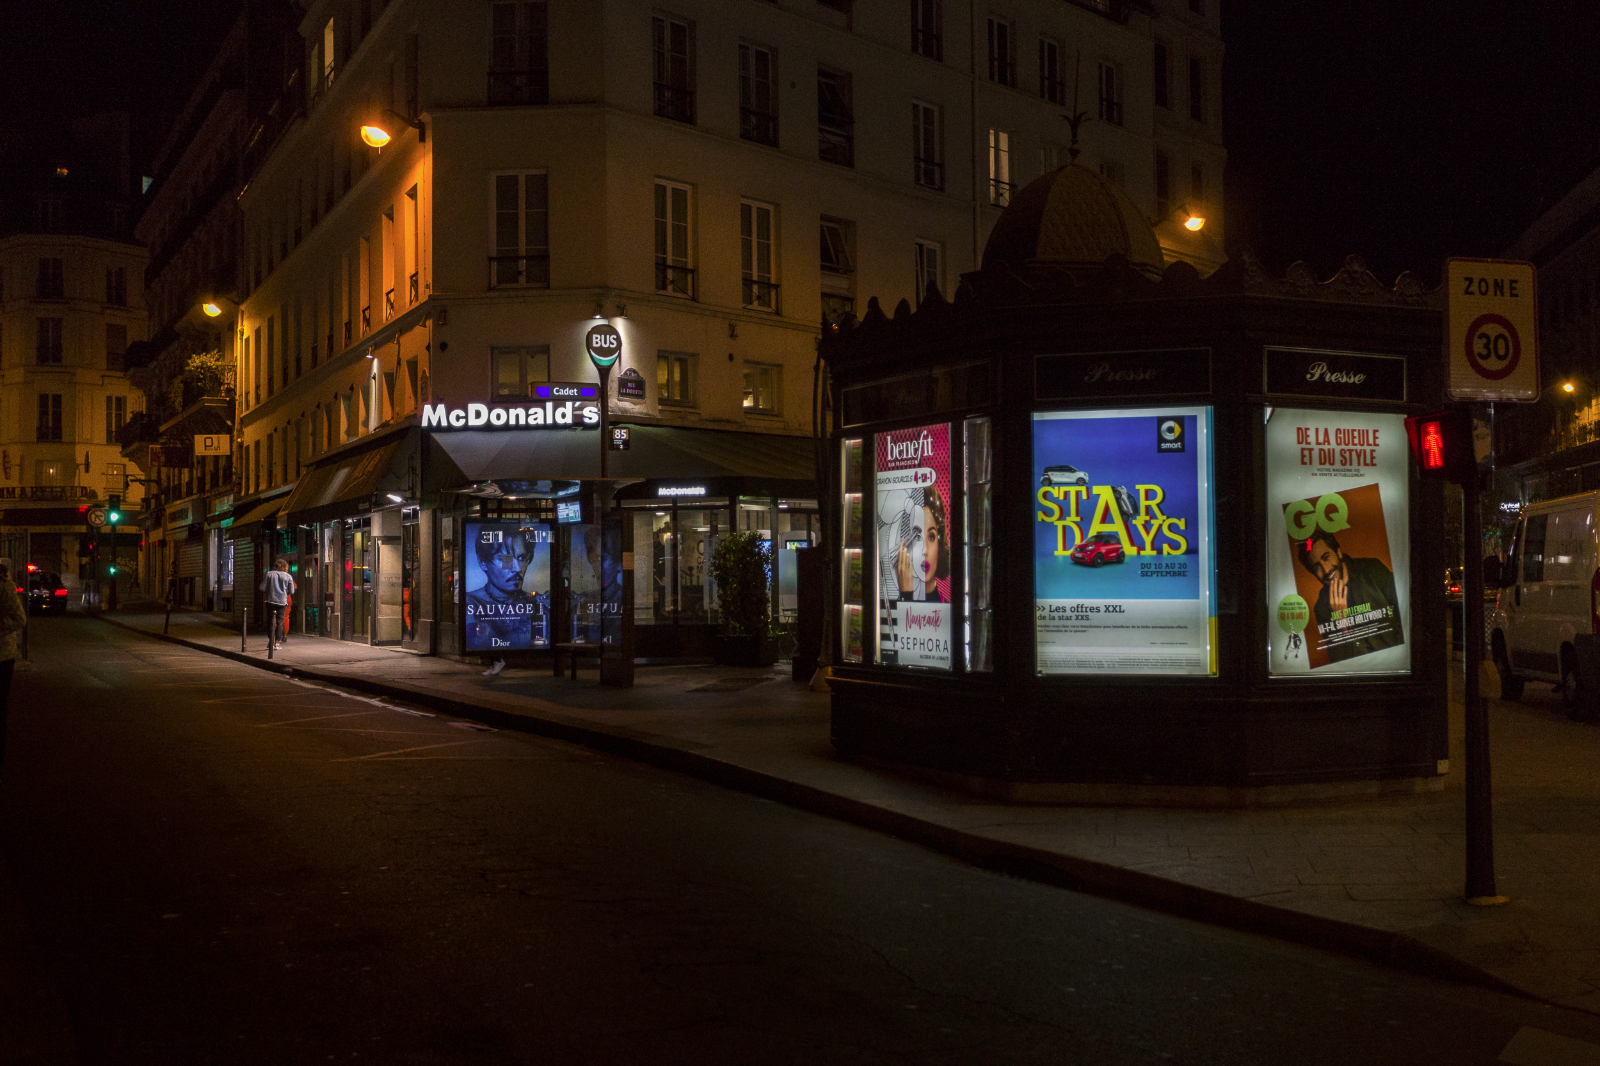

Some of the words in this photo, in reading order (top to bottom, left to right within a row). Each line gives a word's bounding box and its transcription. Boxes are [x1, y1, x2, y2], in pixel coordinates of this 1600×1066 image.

[1463, 276, 1520, 298] ZONE
[591, 334, 618, 349] BUS
[1477, 332, 1510, 361] 30
[1306, 361, 1367, 384] Presse
[553, 386, 578, 397] Cadet
[421, 401, 600, 427] McDonald's
[614, 429, 627, 439] 85
[1296, 427, 1311, 445] DE
[1315, 427, 1331, 445] LA
[1335, 427, 1379, 447] GUEULE
[887, 430, 935, 465] benefit
[1161, 441, 1182, 449] smart
[1300, 447, 1314, 466] ET
[1318, 447, 1336, 466] DU
[1339, 448, 1378, 467] STYLE
[1284, 493, 1351, 541] GQ
[1053, 518, 1190, 556] DAYS
[467, 603, 534, 615] SAUVAGE
[1037, 613, 1047, 621] de
[1048, 613, 1056, 621] la
[1049, 604, 1067, 613] Les
[1070, 603, 1101, 613] offres
[1104, 604, 1125, 613] XXL
[905, 606, 943, 632] Nouveauté
[492, 637, 511, 647] Dior
[900, 636, 949, 653] SEPHORA
